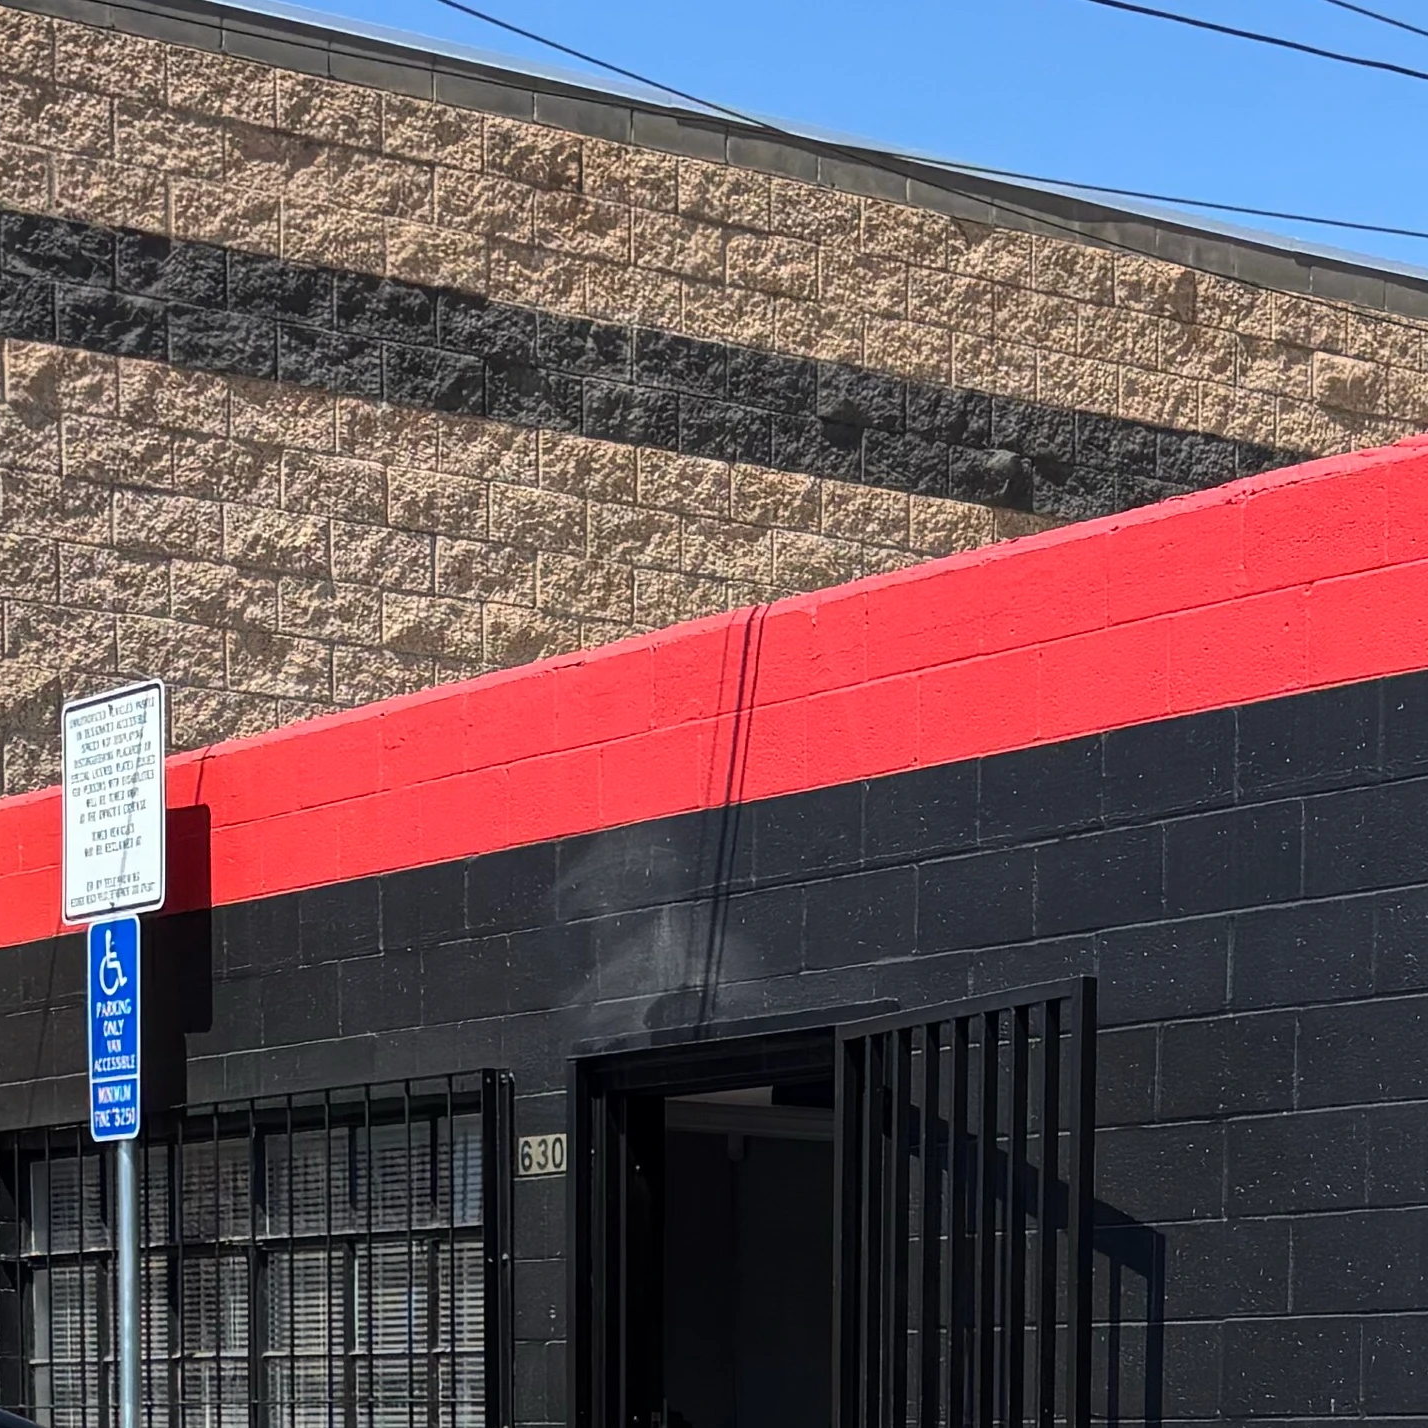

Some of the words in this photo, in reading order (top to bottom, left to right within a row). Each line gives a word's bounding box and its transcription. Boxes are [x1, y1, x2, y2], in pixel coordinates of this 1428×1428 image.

[96, 999, 131, 1018] PARKING
[103, 1019, 124, 1037] ONLY
[94, 1055, 135, 1072] ACCESSIBLE
[98, 1084, 131, 1104] MINIMUM
[95, 1109, 111, 1128] FINE
[521, 1137, 563, 1171] 630
